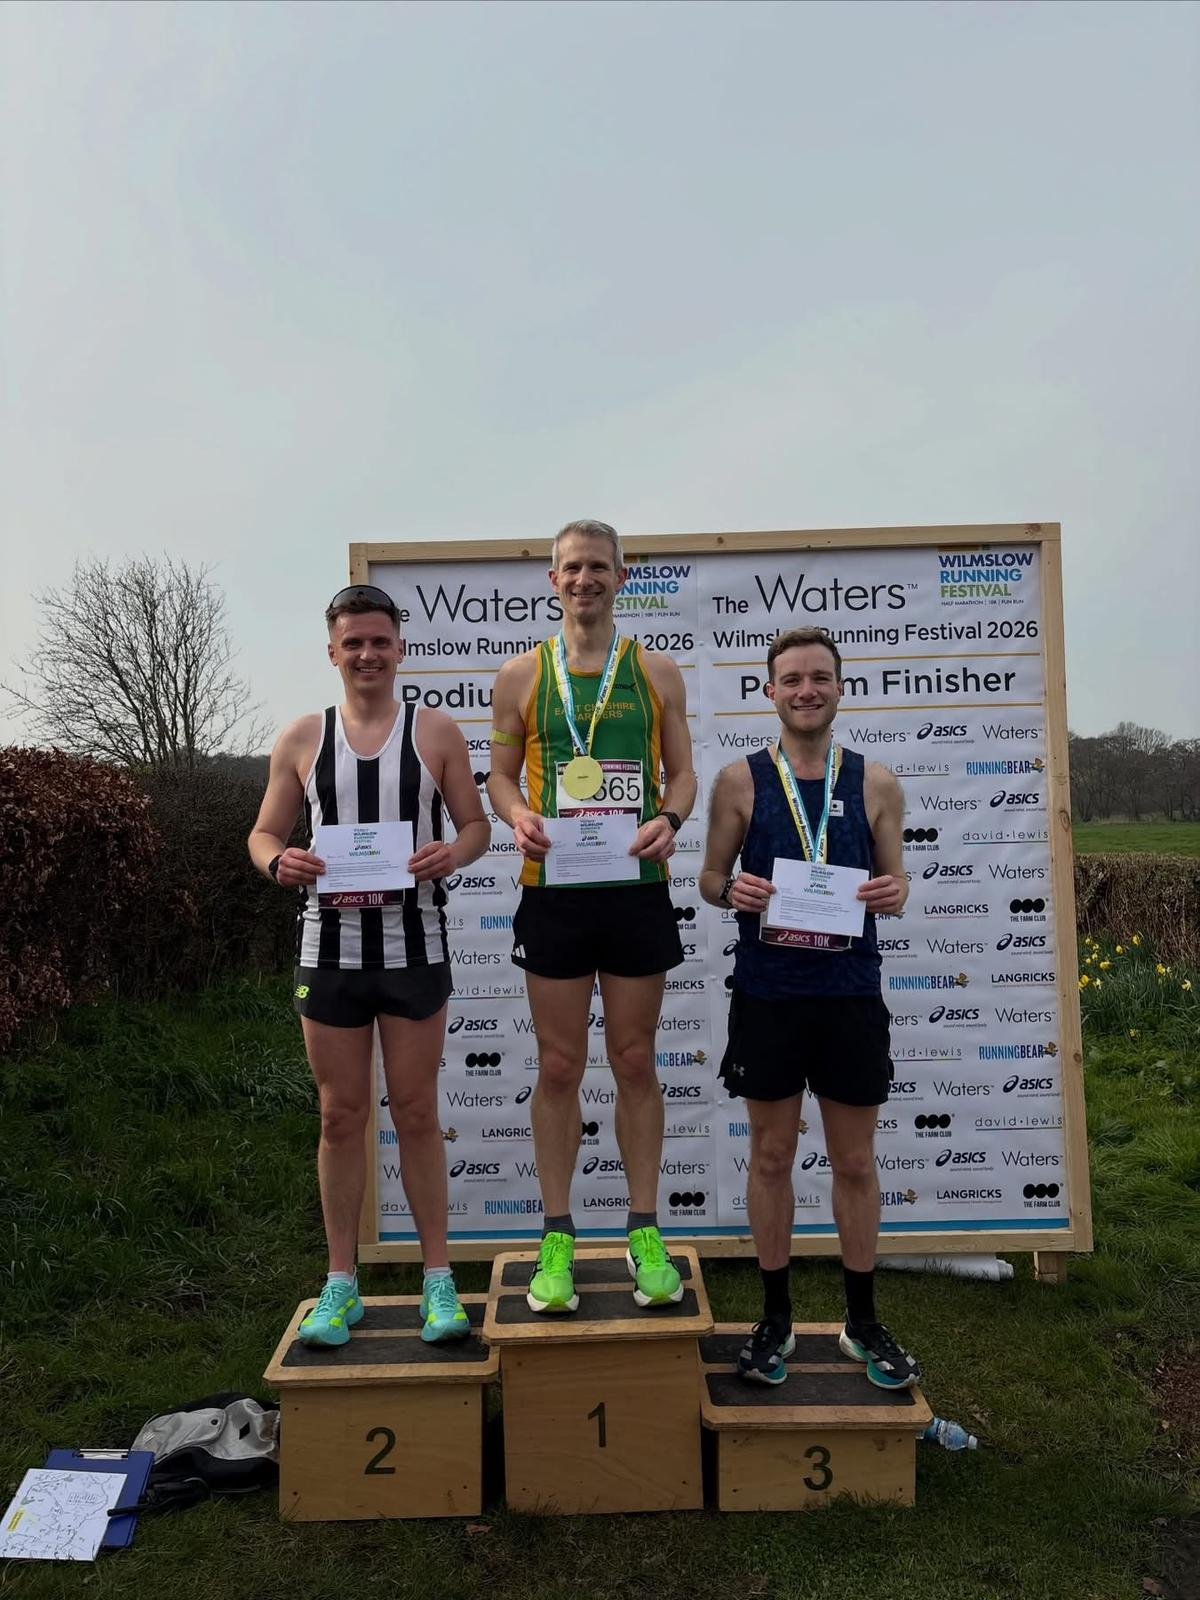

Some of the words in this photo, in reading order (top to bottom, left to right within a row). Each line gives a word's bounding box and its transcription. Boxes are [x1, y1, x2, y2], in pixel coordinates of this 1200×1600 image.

[939, 553, 1033, 568] WILMSLOW
[627, 566, 691, 579] MSLOW
[940, 568, 1022, 583] RUNNING
[621, 581, 679, 595] NNING
[941, 584, 1011, 598] FESTIVAL
[416, 584, 563, 623] Waters
[615, 596, 668, 610] STIVAL
[712, 596, 749, 614] The
[713, 628, 780, 648] Wilmsl
[905, 621, 981, 641] Festival
[987, 620, 1038, 639] 2026
[403, 638, 471, 656] lmslow
[644, 633, 694, 651] 2026
[882, 667, 1016, 695] Finisher
[402, 683, 493, 708] Podiu
[966, 761, 1031, 775] RUNNINGBEAR
[669, 875, 696, 888] ters
[368, 893, 384, 905] 10K
[924, 904, 989, 915] LANGRICKS
[480, 915, 513, 930] RUNNIN
[814, 935, 830, 947] 10K
[664, 980, 705, 990] GRICKS
[889, 975, 955, 990] RUNNINGBEAR
[991, 972, 1055, 983] LANGRICKS
[890, 1013, 919, 1026] ters
[979, 1045, 1044, 1060] RUNNINGBEAR
[481, 1128, 531, 1138] LANGRIC
[937, 1189, 1002, 1200] LANGRICKS
[485, 1200, 543, 1214] RUNNINGBEA
[584, 1198, 630, 1208] LANGRIC
[587, 1402, 606, 1448] 1
[364, 1427, 396, 1476] 2
[802, 1445, 834, 1491] 3
